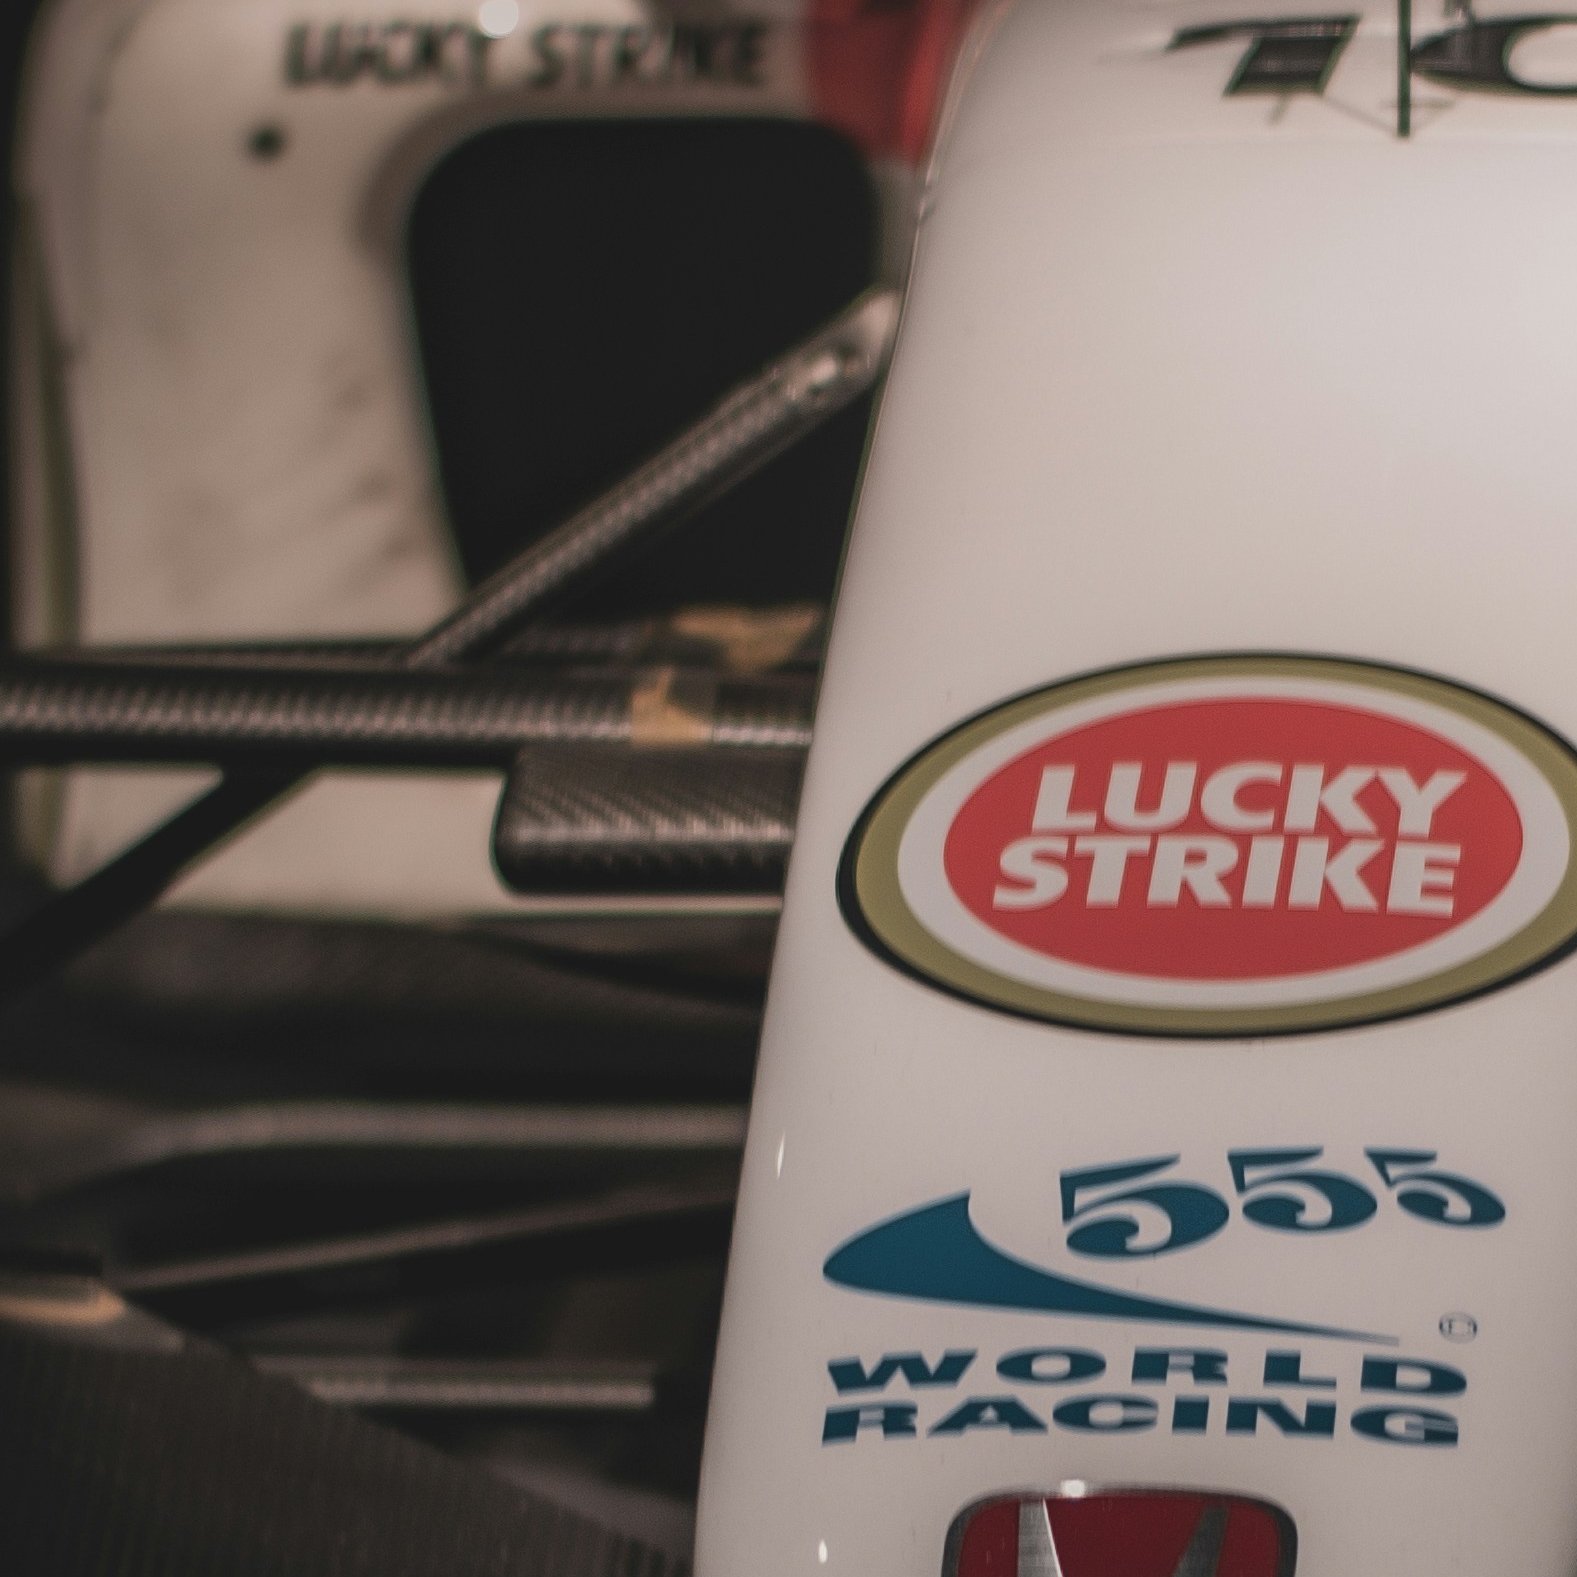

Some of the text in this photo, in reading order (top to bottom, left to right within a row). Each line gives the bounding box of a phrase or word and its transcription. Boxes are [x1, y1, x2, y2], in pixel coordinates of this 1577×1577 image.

[284, 20, 768, 90] LUCKY STRIKE
[1031, 760, 1468, 839] LUCKY
[992, 834, 1462, 918] STRIKE
[1059, 1145, 1507, 1260] 555
[826, 1345, 1468, 1397] WORLD
[821, 1393, 1461, 1449] RACING
